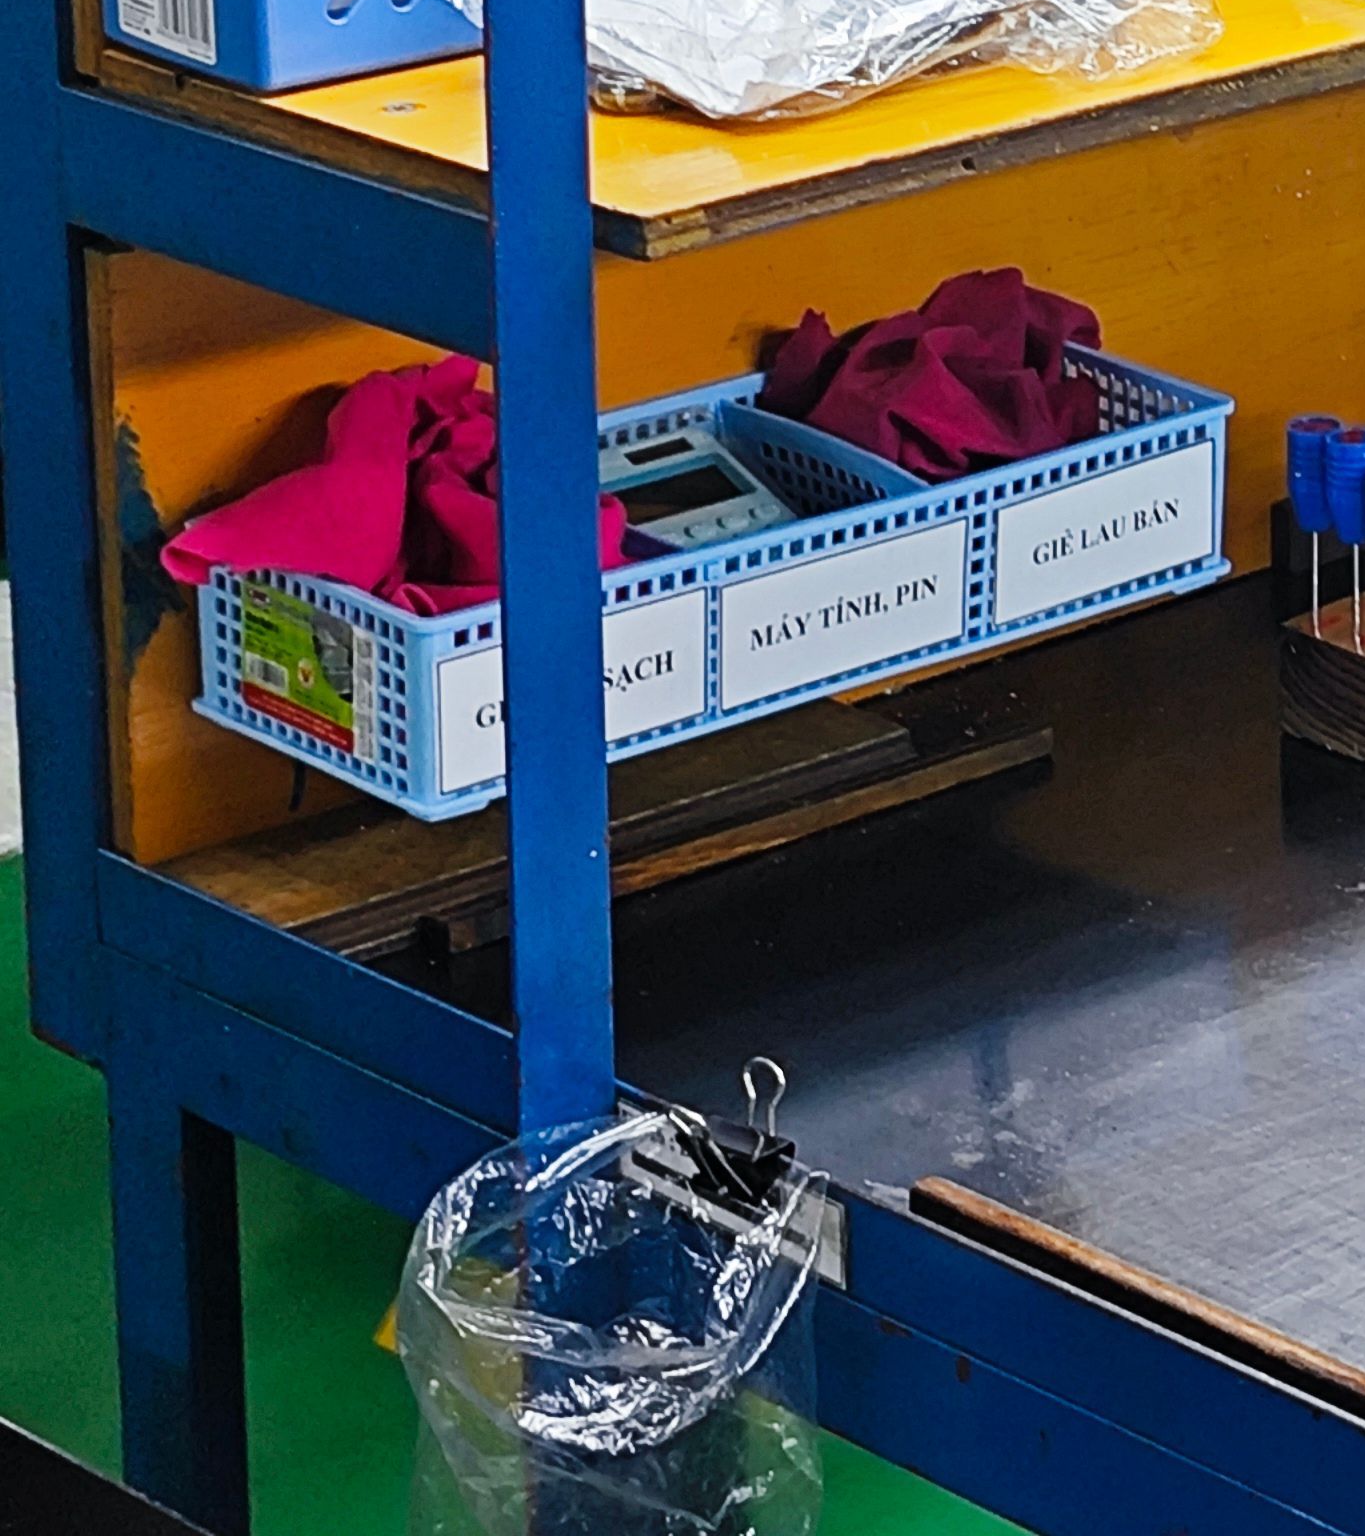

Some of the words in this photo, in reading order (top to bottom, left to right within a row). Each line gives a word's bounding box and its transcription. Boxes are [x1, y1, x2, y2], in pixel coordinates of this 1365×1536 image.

[1080, 515, 1127, 550] LAU
[750, 612, 812, 652] MÁY
[817, 595, 889, 630] TÍNH,
[895, 574, 938, 607] PIN
[475, 699, 504, 729] GI
[602, 649, 675, 693] SẠCH
